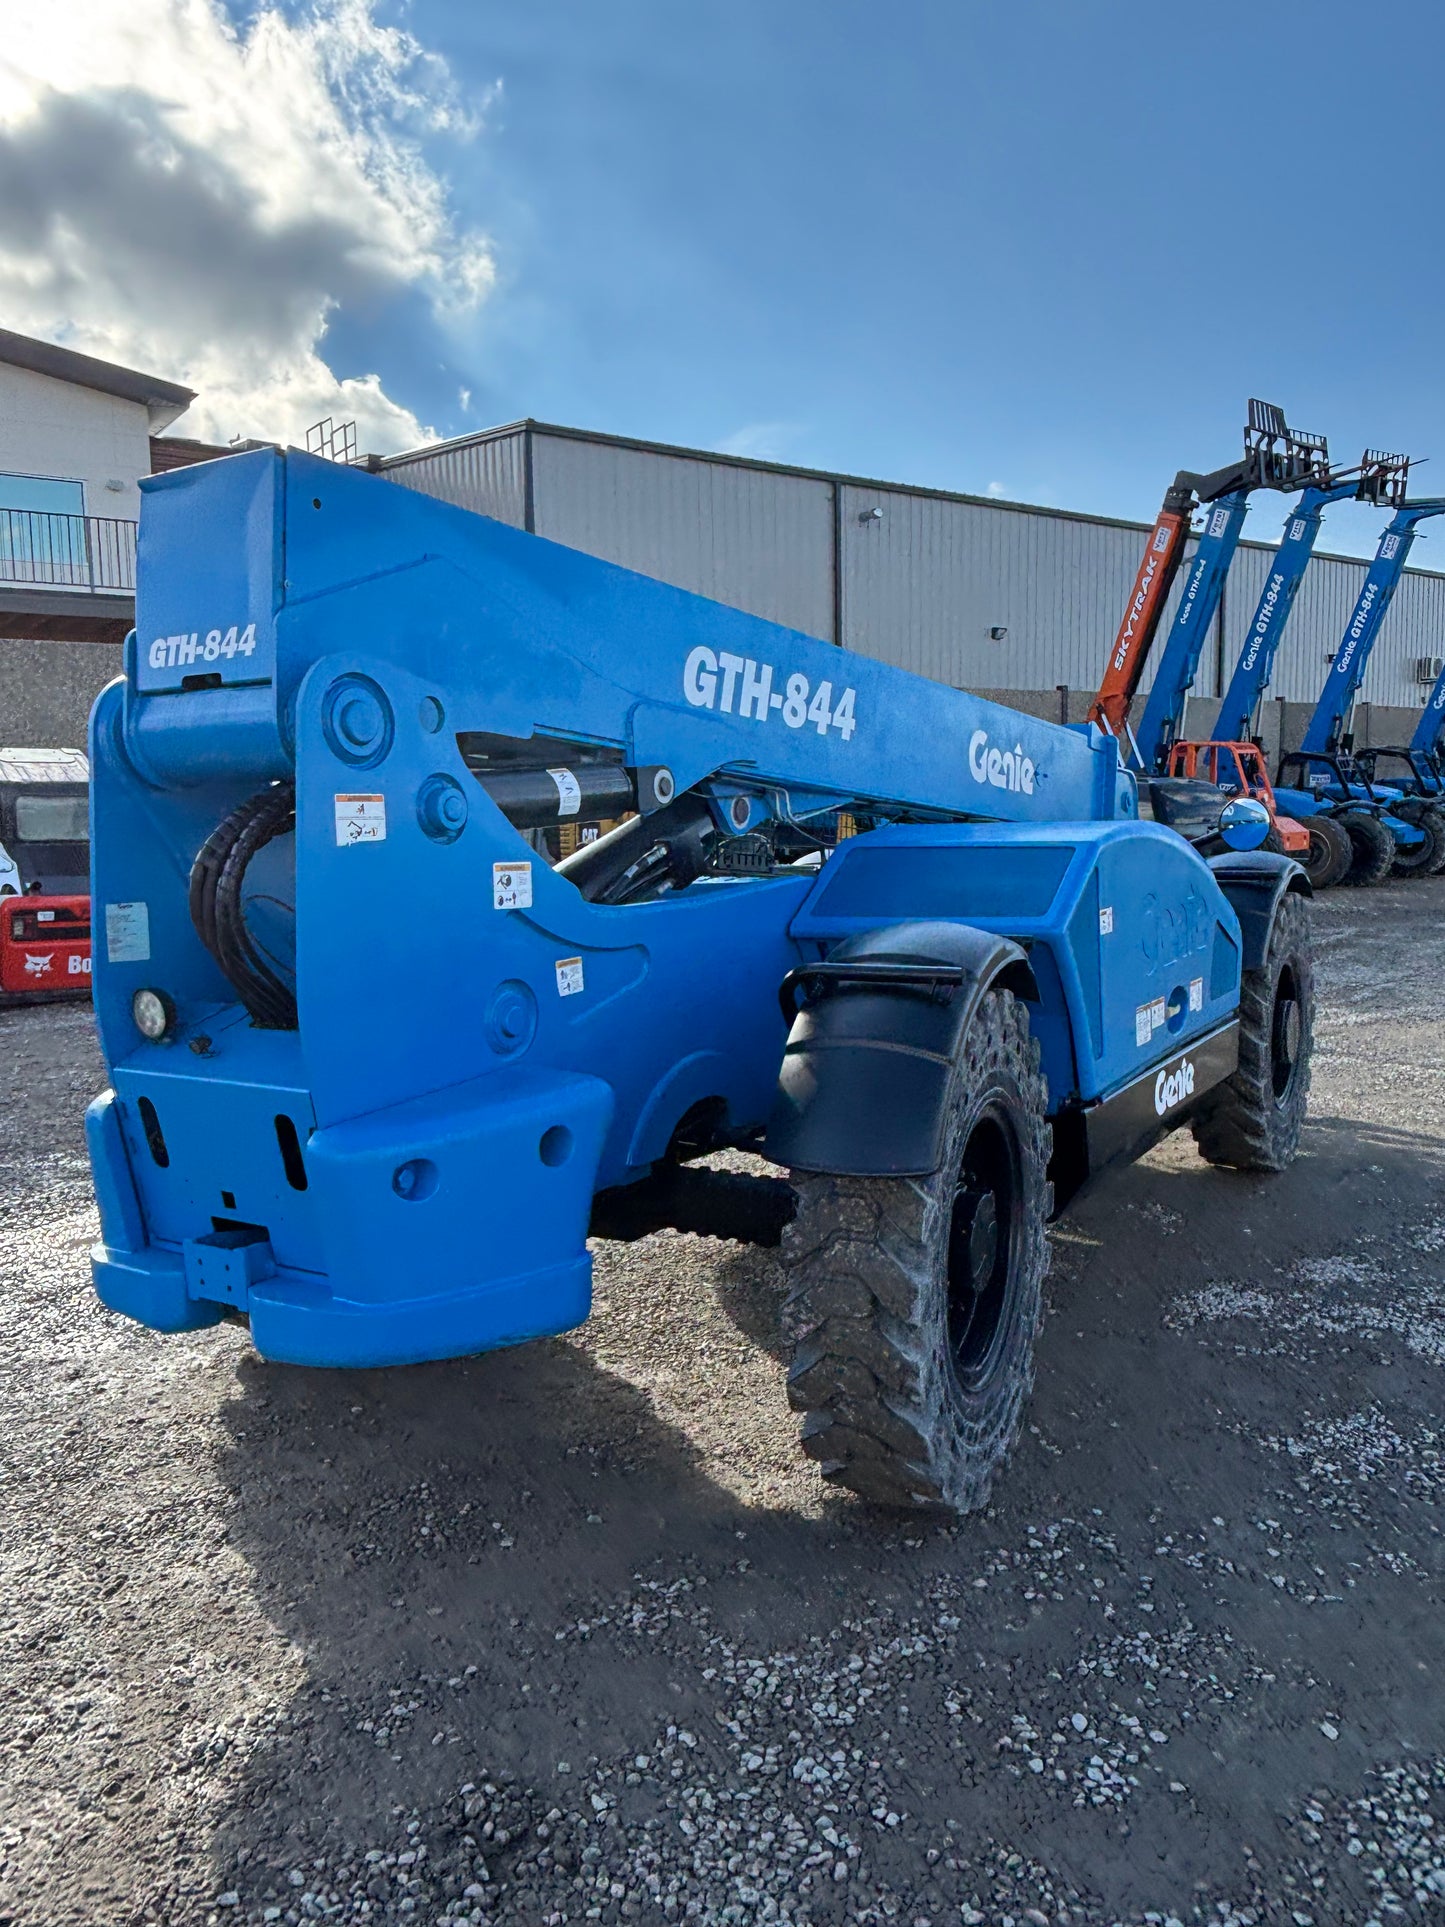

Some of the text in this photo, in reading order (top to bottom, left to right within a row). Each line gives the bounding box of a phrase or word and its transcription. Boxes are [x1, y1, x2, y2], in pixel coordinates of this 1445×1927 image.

[148, 623, 256, 669] GTH-844
[1114, 555, 1157, 671] SKYTRAK
[1242, 573, 1284, 671] Genie GTH-844
[1337, 583, 1379, 673] Genie GTH-844
[683, 645, 857, 741] GTH-844
[969, 729, 1035, 795] Genie
[582, 828, 598, 844] CAT
[1154, 1057, 1195, 1116] Genie
